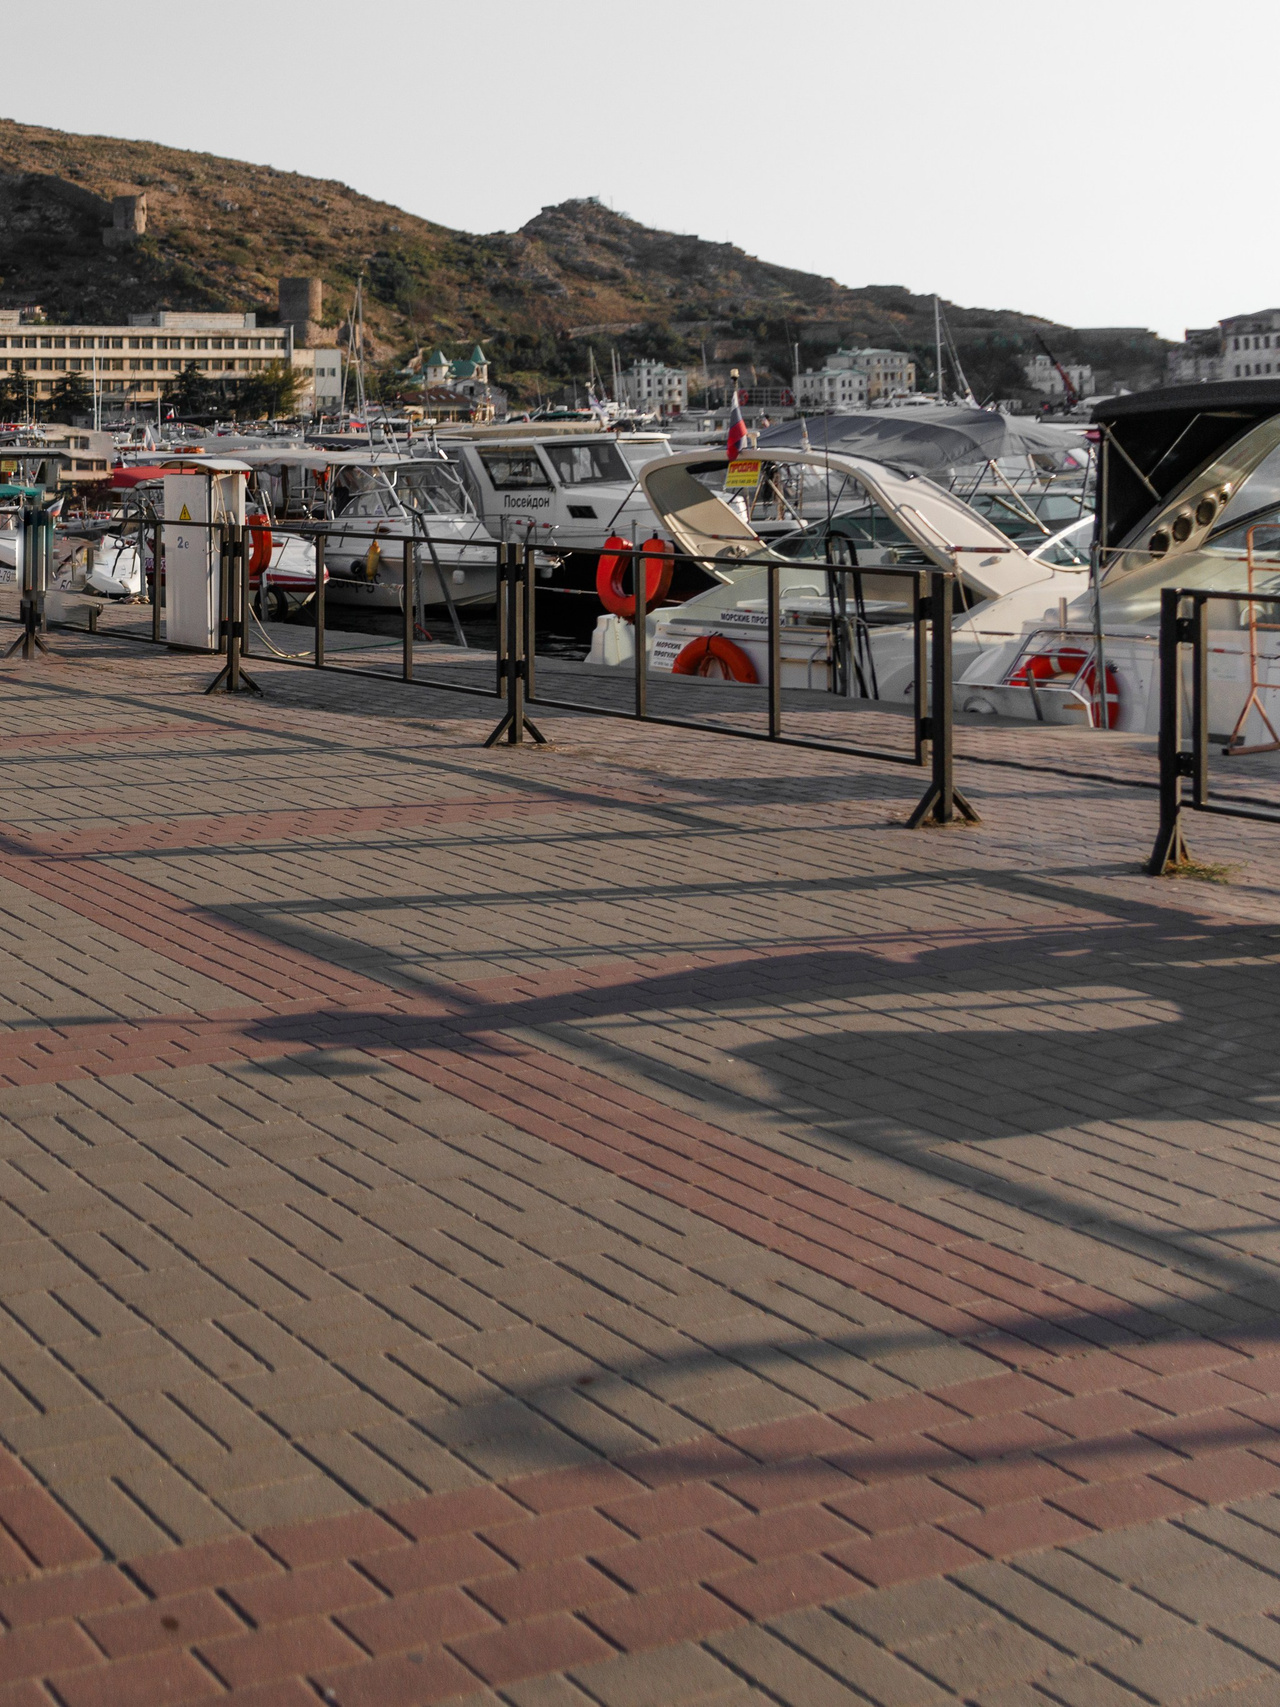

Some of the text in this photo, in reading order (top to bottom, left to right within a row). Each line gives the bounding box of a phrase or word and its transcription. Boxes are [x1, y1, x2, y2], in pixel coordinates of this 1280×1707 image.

[504, 494, 550, 510] Посейдон
[721, 612, 786, 626] МОРСКИЕ ПРОГИ
[656, 641, 682, 650] МОРСКИЕ
